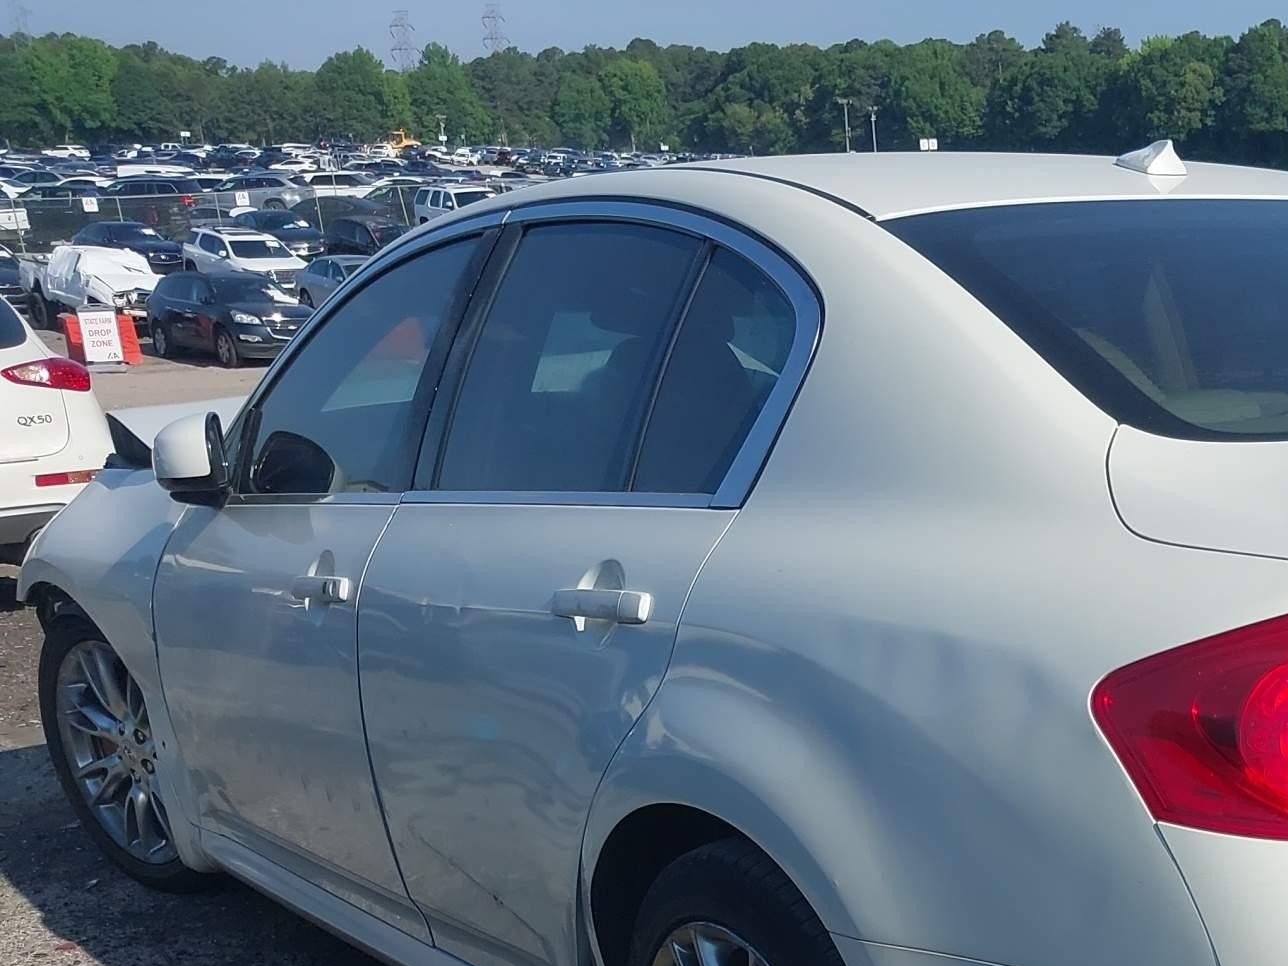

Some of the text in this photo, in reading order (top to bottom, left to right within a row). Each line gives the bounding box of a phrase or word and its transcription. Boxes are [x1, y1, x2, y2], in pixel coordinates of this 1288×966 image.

[88, 329, 112, 337] DROP
[91, 339, 113, 348] ZONE
[17, 414, 53, 427] QX50
